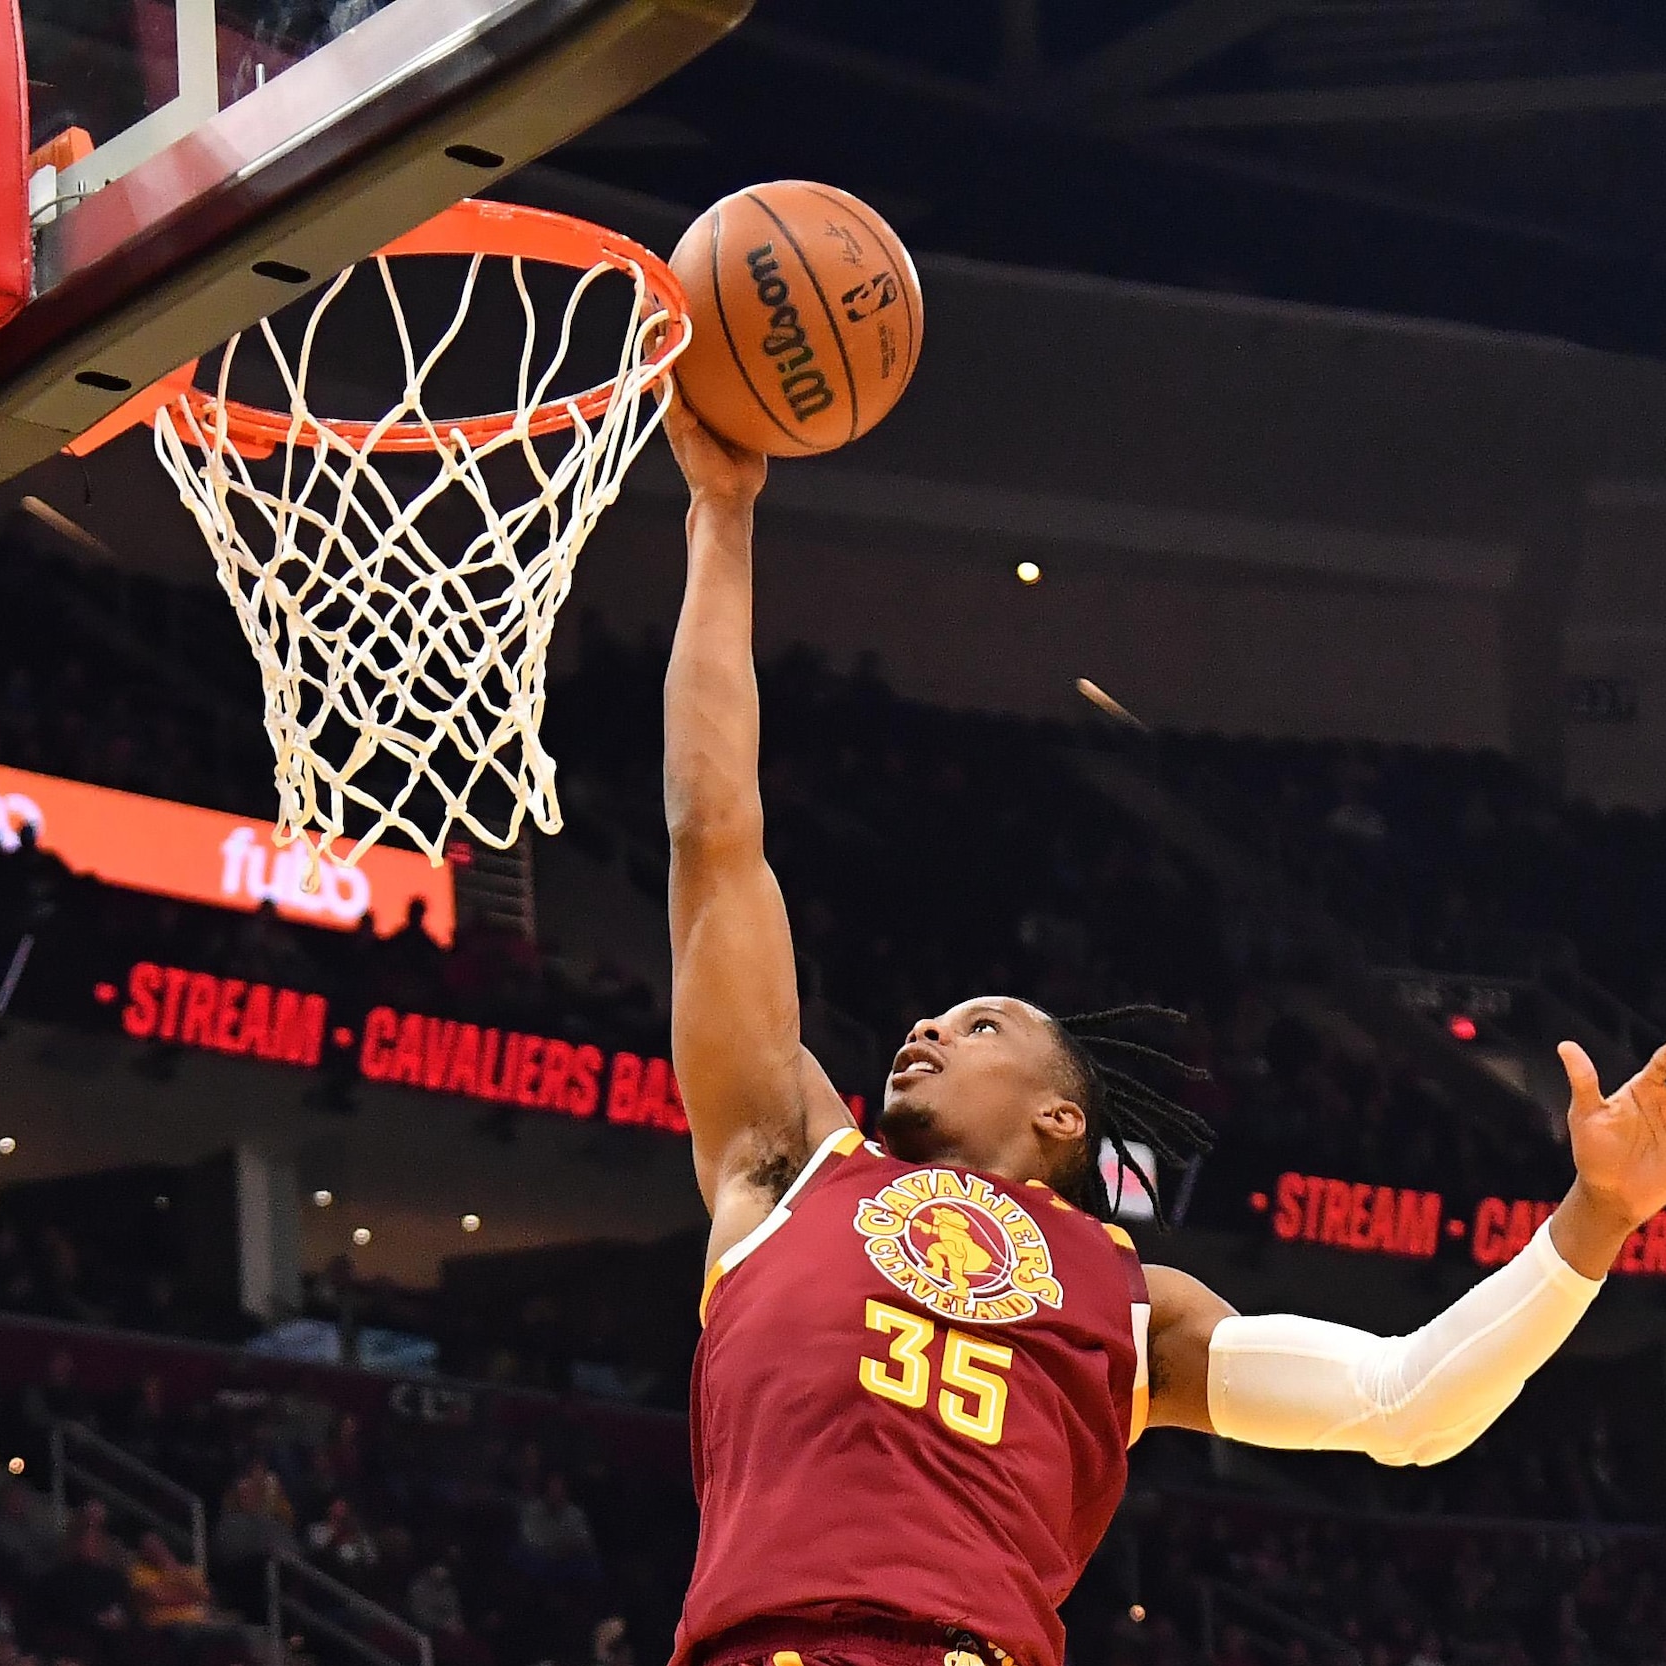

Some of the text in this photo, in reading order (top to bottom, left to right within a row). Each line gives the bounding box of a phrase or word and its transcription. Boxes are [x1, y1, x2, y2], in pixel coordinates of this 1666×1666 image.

[746, 240, 835, 423] Wilson
[123, 961, 331, 1068] STREAM
[360, 1006, 604, 1118] CAVALIERS
[853, 1169, 1064, 1310] CAVALIERS
[864, 1237, 1038, 1324] CLEVELAND
[1273, 1171, 1441, 1259] STREAM
[859, 1298, 1013, 1446] 35
